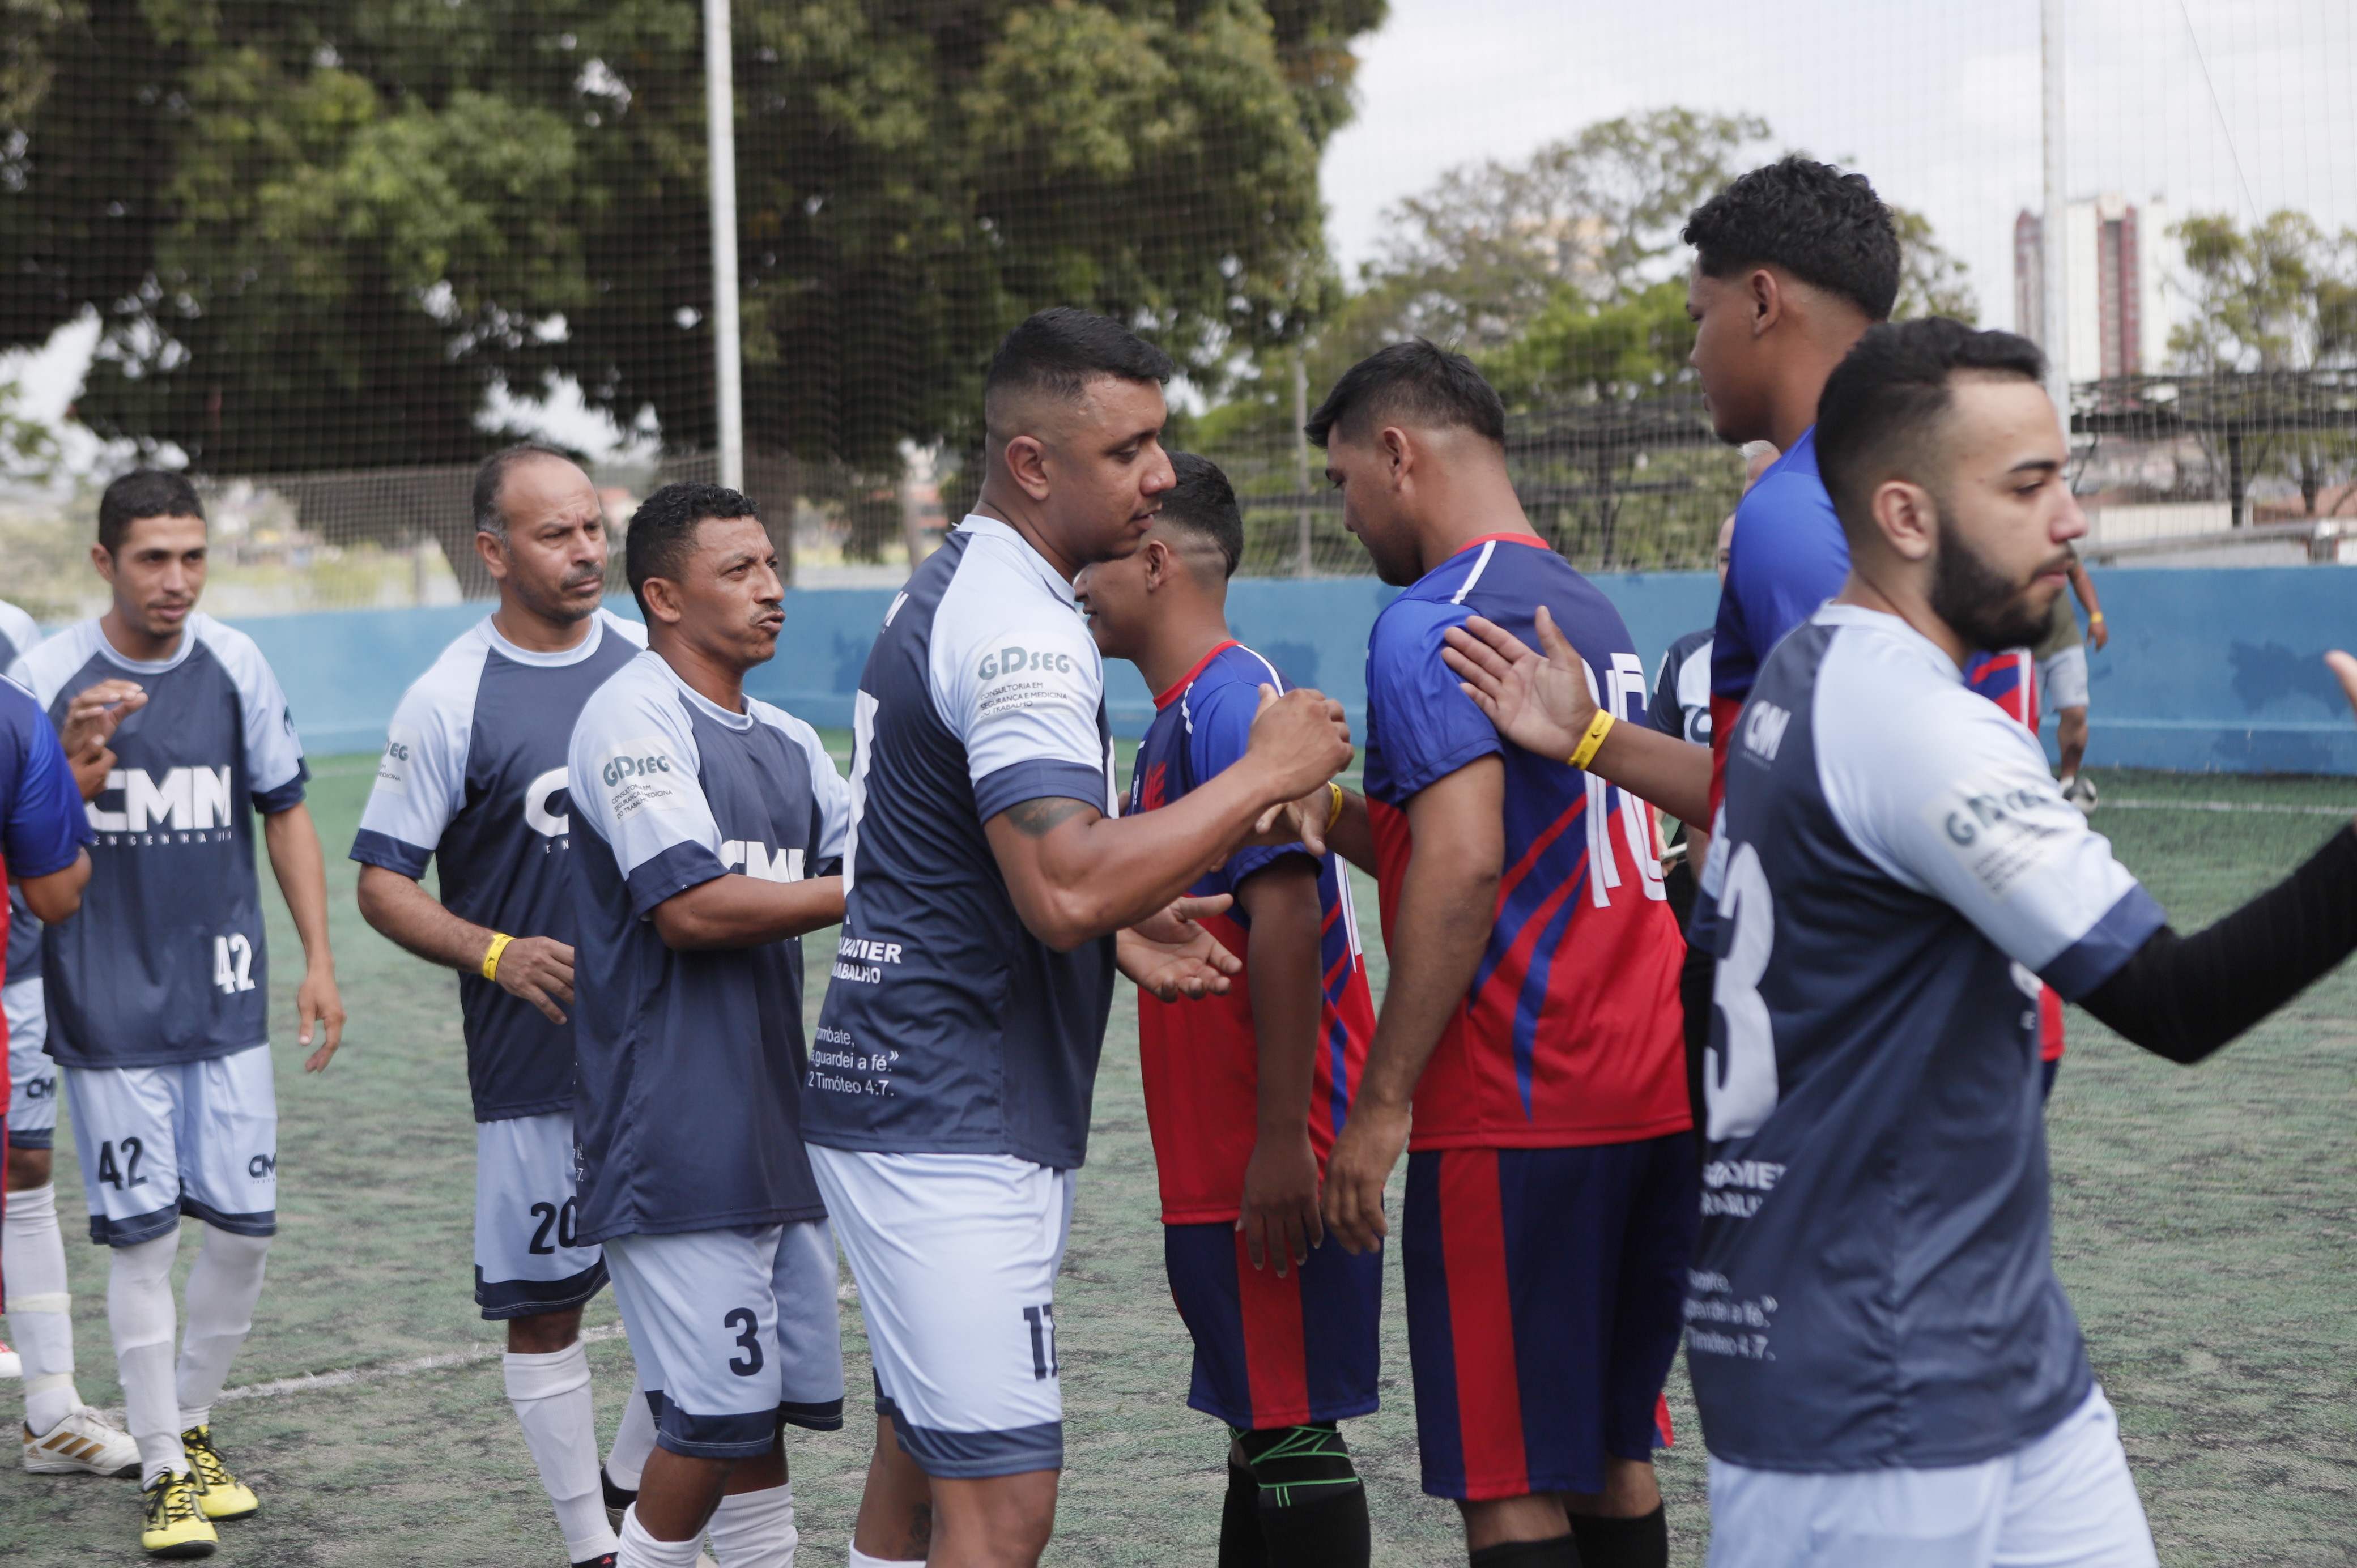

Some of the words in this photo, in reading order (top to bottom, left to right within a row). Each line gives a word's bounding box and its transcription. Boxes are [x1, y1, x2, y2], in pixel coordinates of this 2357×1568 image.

[980, 694, 1024, 711] SEGURANÇA
[214, 933, 256, 995] 42
[809, 1071, 815, 1087] 2
[816, 1072, 862, 1094] Timóteo
[857, 1056, 867, 1070] a
[99, 1136, 150, 1191] 42
[529, 1195, 577, 1255] 20
[724, 1307, 764, 1377] 3
